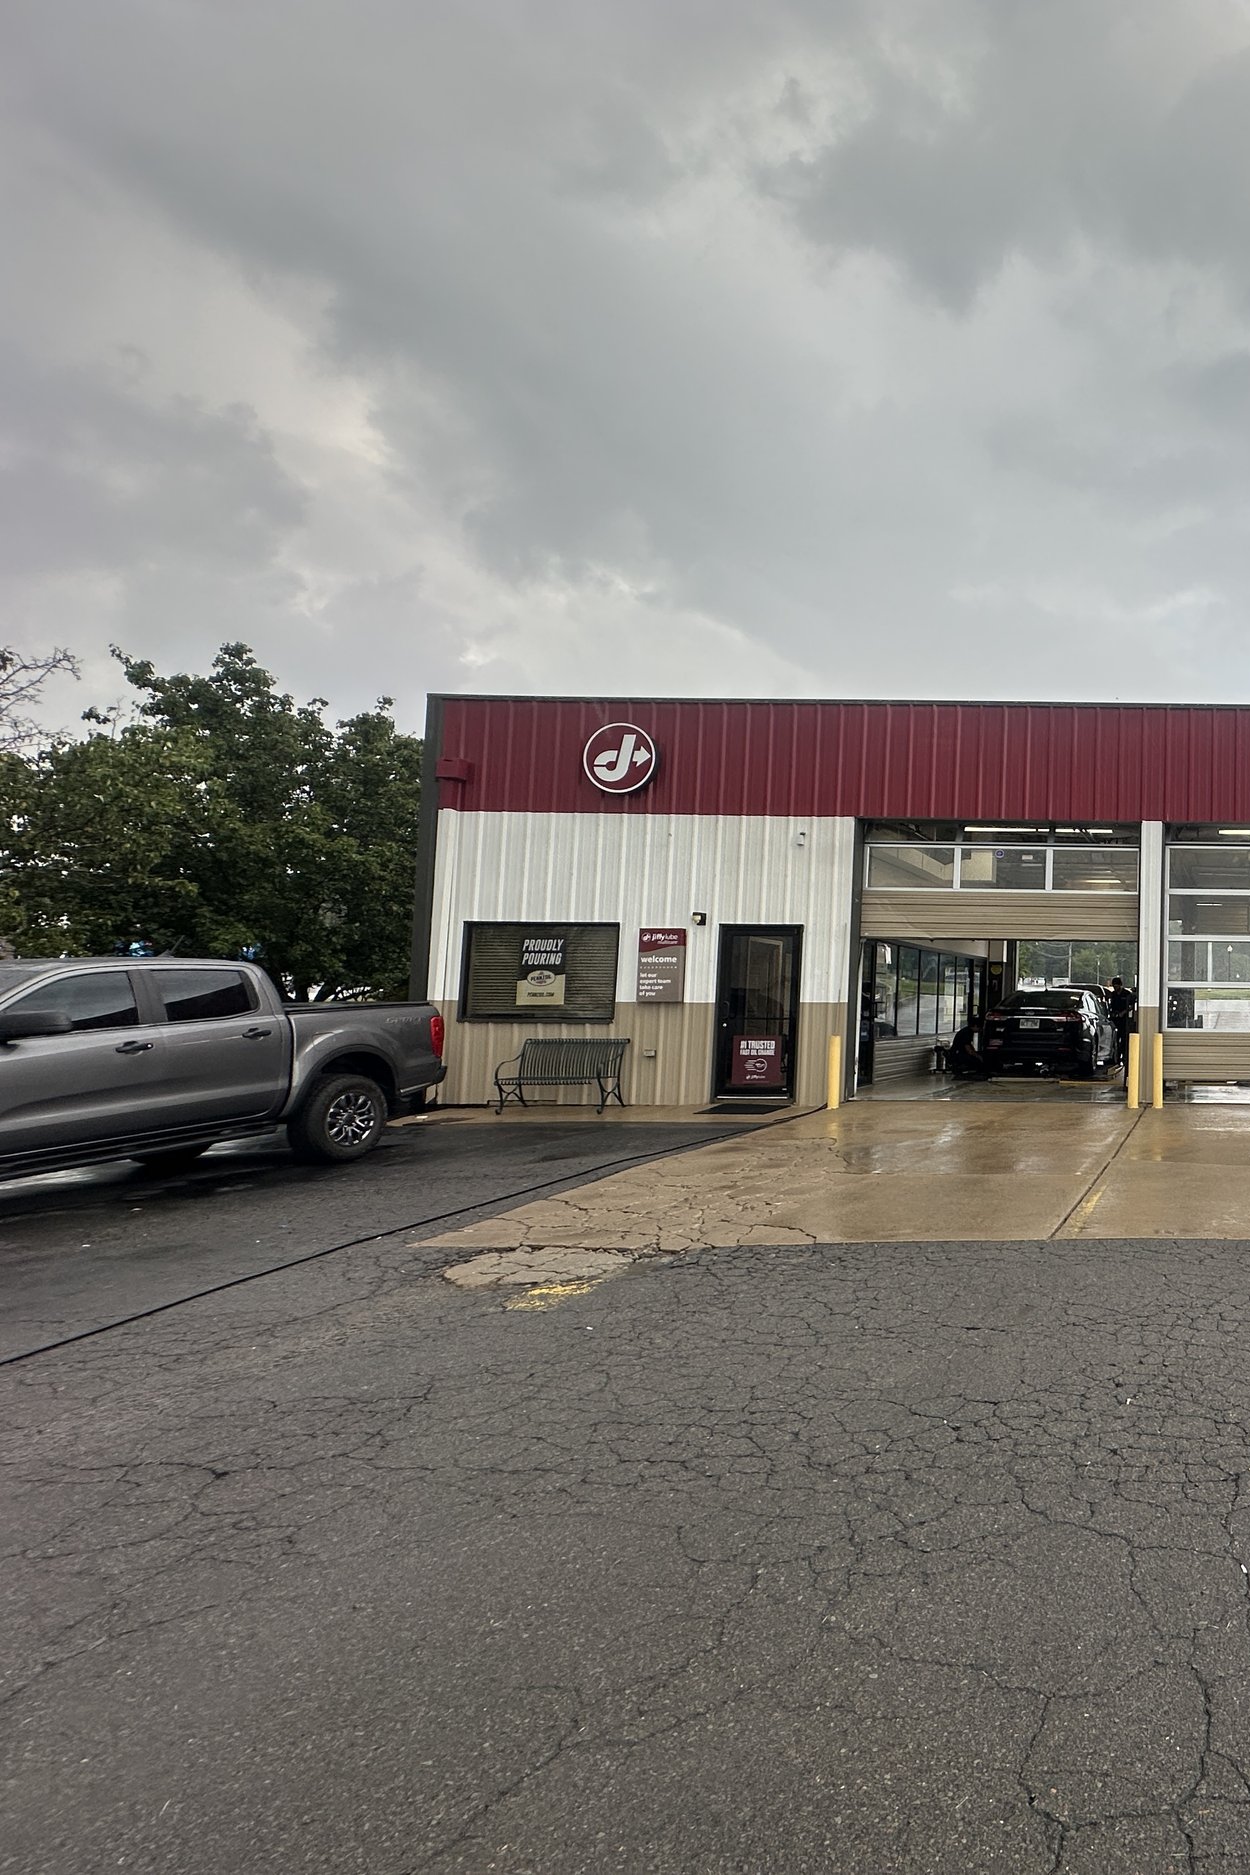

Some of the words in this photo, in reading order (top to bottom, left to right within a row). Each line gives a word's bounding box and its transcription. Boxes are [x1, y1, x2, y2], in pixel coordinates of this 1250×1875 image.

[522, 939, 565, 951] PROUDLY
[521, 953, 562, 965] POURING
[640, 955, 677, 963] welcome
[748, 1040, 776, 1049] TRUSTED
